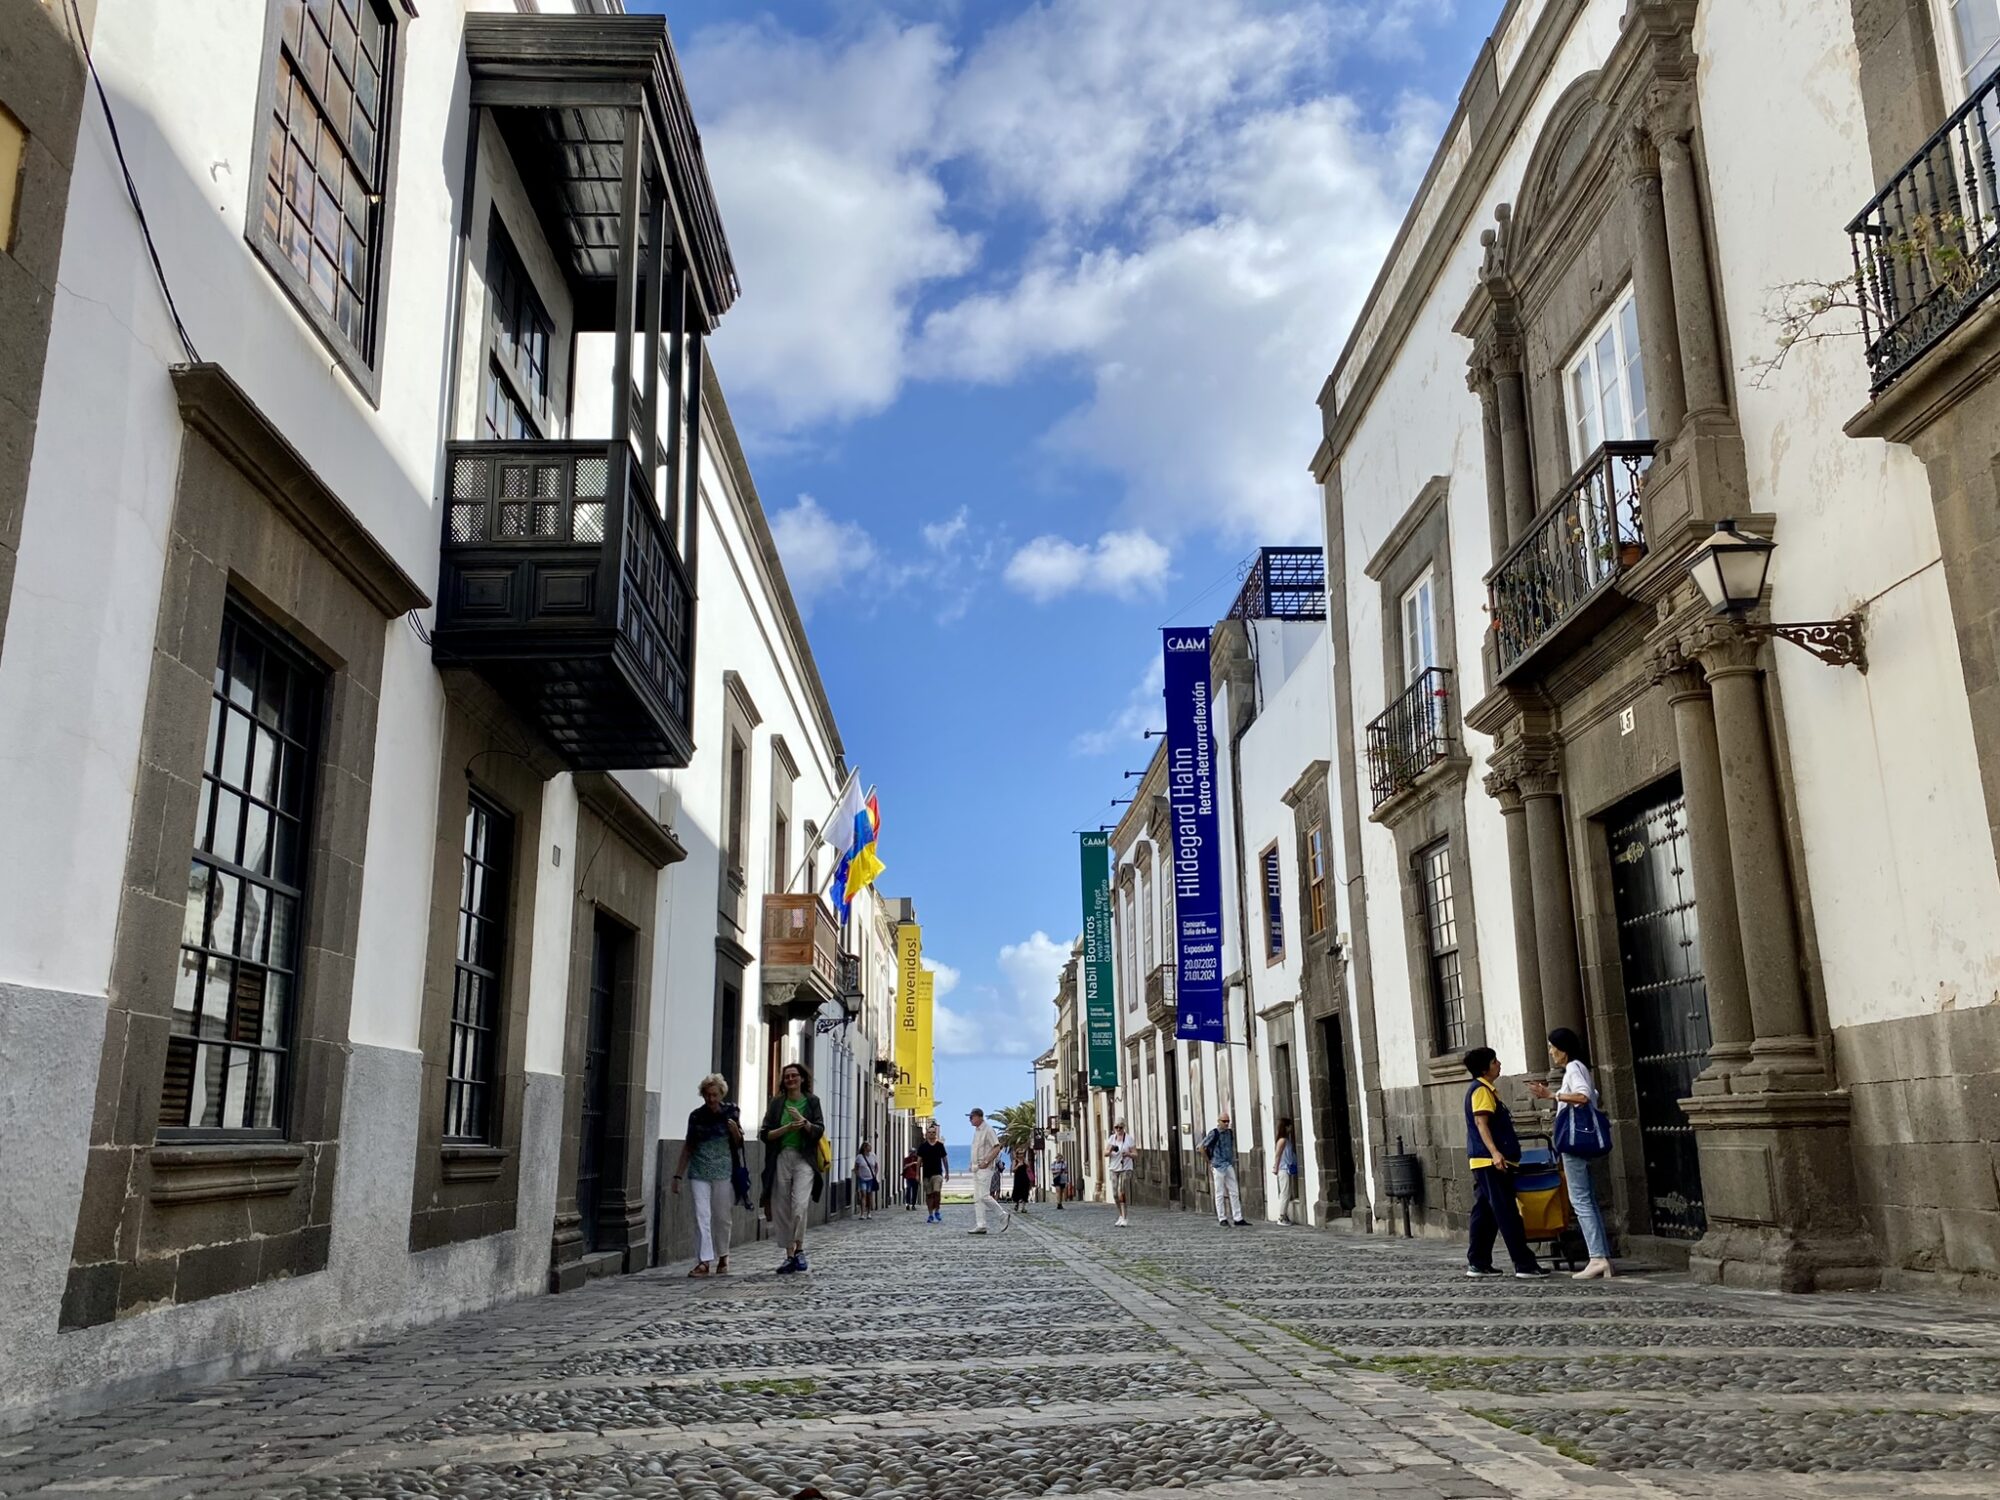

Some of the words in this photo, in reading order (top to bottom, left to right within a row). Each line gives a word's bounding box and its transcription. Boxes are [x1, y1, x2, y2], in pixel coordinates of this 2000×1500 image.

[1167, 637, 1206, 650] CAAM
[1171, 747, 1195, 797] Hahn
[1191, 681, 1212, 815] Retro-Retrorreflexión
[1082, 837, 1106, 846] CAAM
[1172, 803, 1203, 897] Hildegard
[1086, 915, 1097, 963] Boutros
[1184, 943, 1214, 955] Exposición
[903, 937, 917, 1032] ¡Bienvenidos!
[1086, 966, 1098, 999] Nabil
